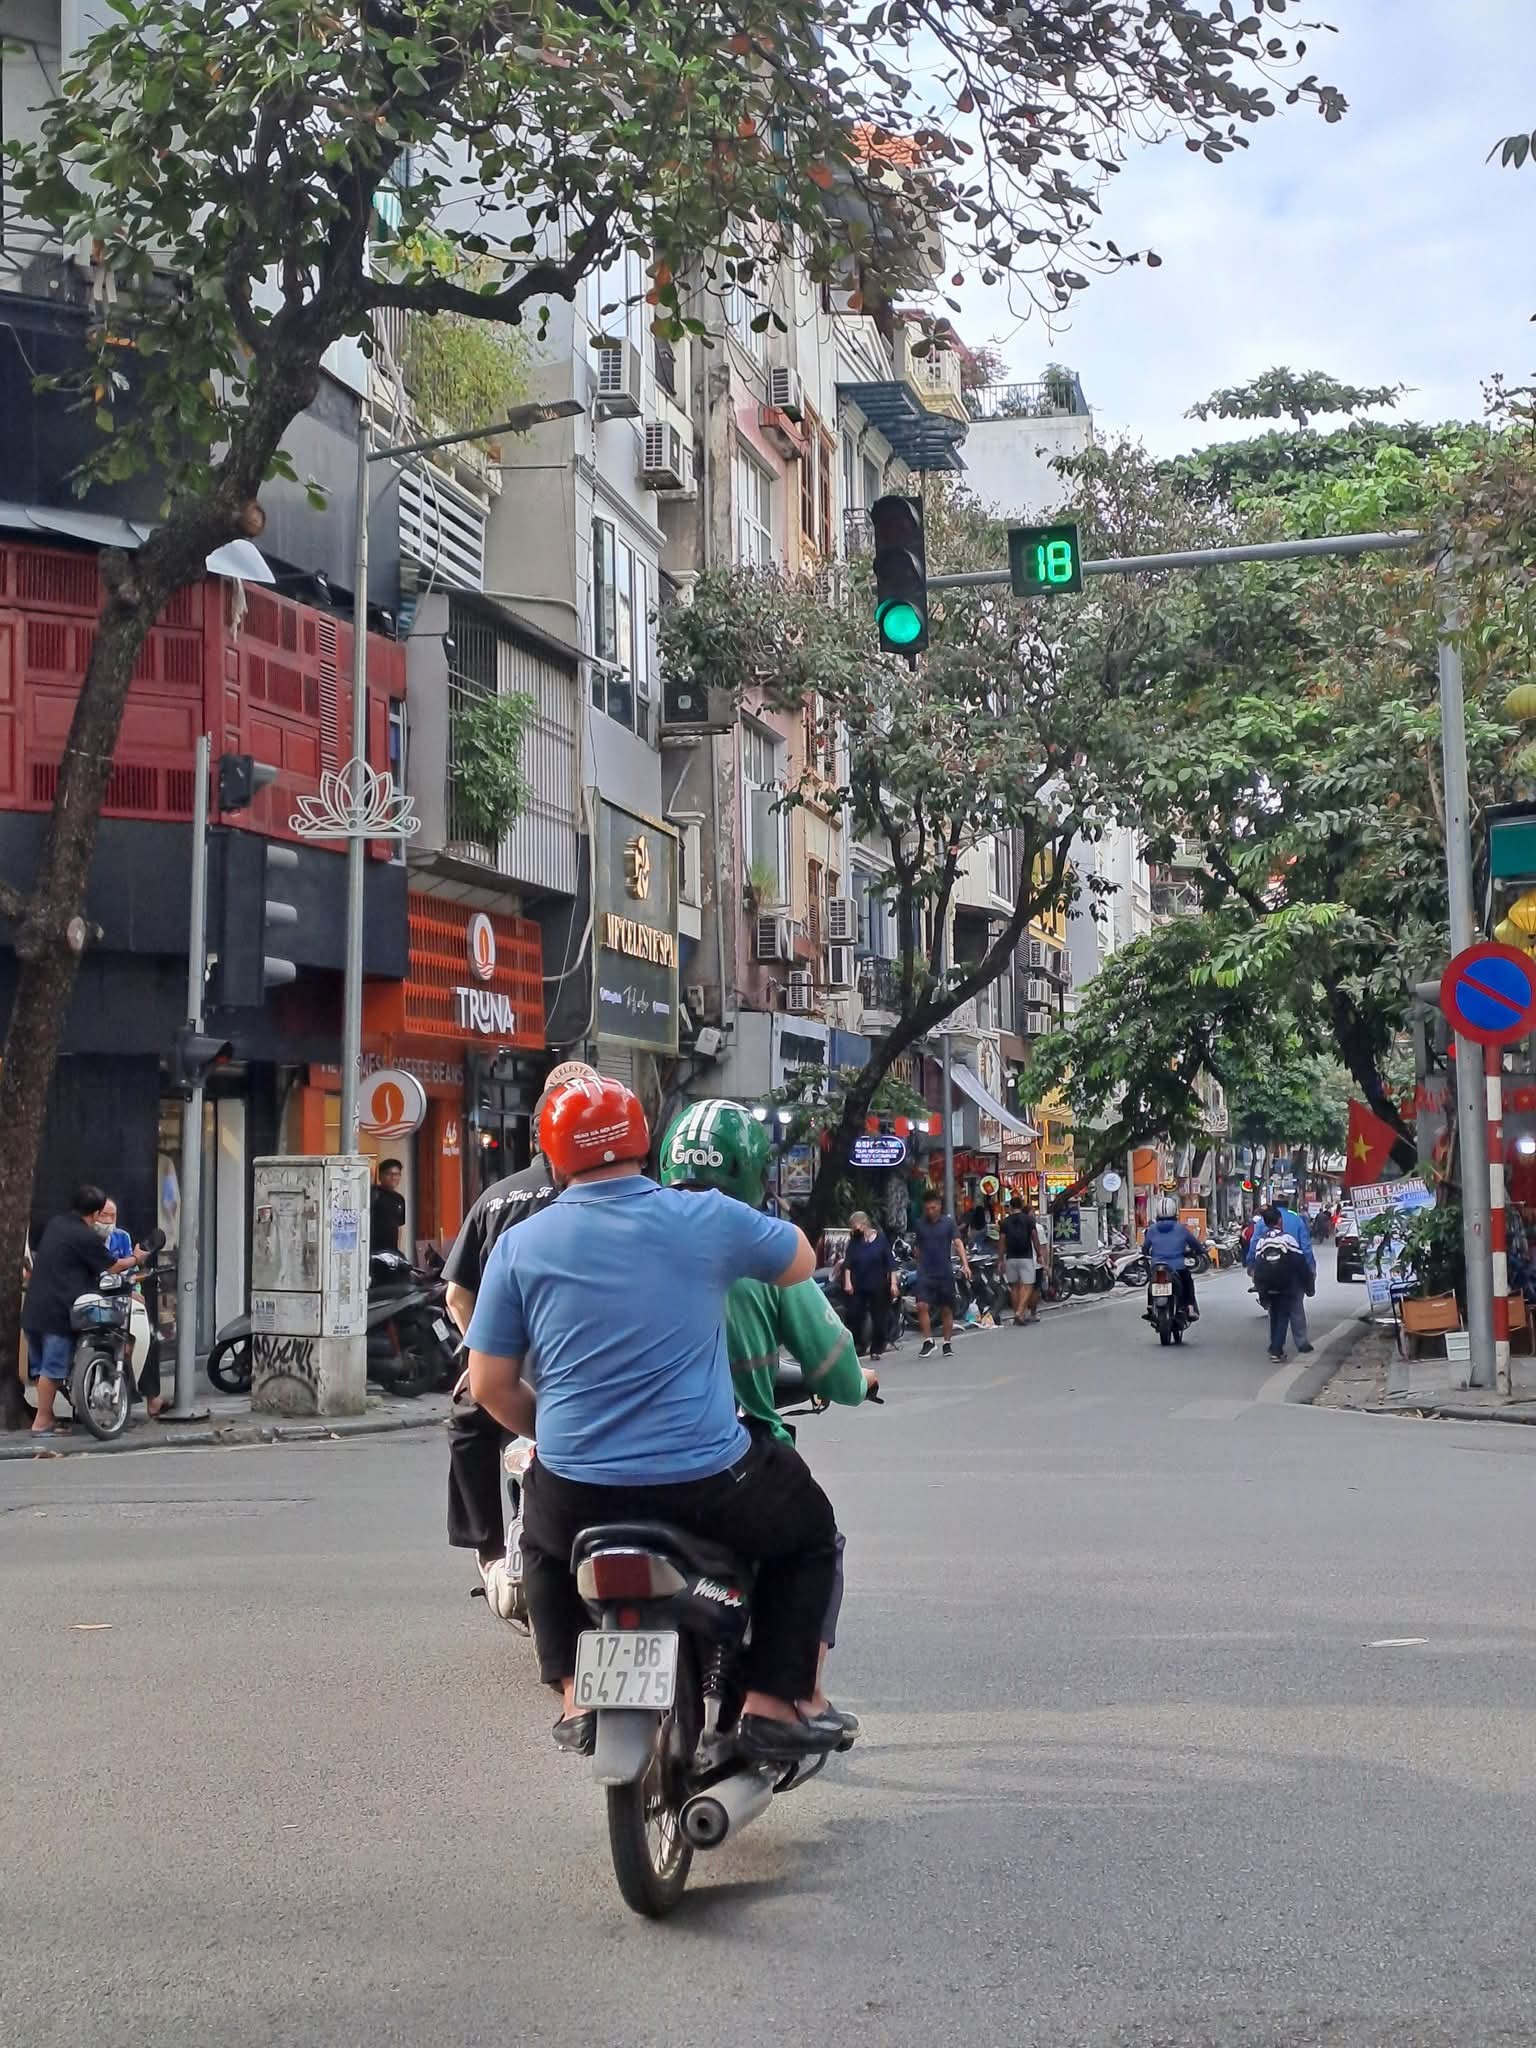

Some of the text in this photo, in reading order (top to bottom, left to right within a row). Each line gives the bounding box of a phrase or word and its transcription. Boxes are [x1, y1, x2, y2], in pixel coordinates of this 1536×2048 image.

[1037, 541, 1072, 582] 18
[455, 986, 515, 1035] TRUNA
[432, 1061, 465, 1086] BEANS
[671, 1142, 723, 1167] Grab
[1353, 1187, 1386, 1201] MONEY
[1386, 1179, 1428, 1197] EXCHANG
[692, 1577, 730, 1602] Wave
[595, 1636, 662, 1668] 17-B6
[580, 1671, 669, 1703] 647.75
